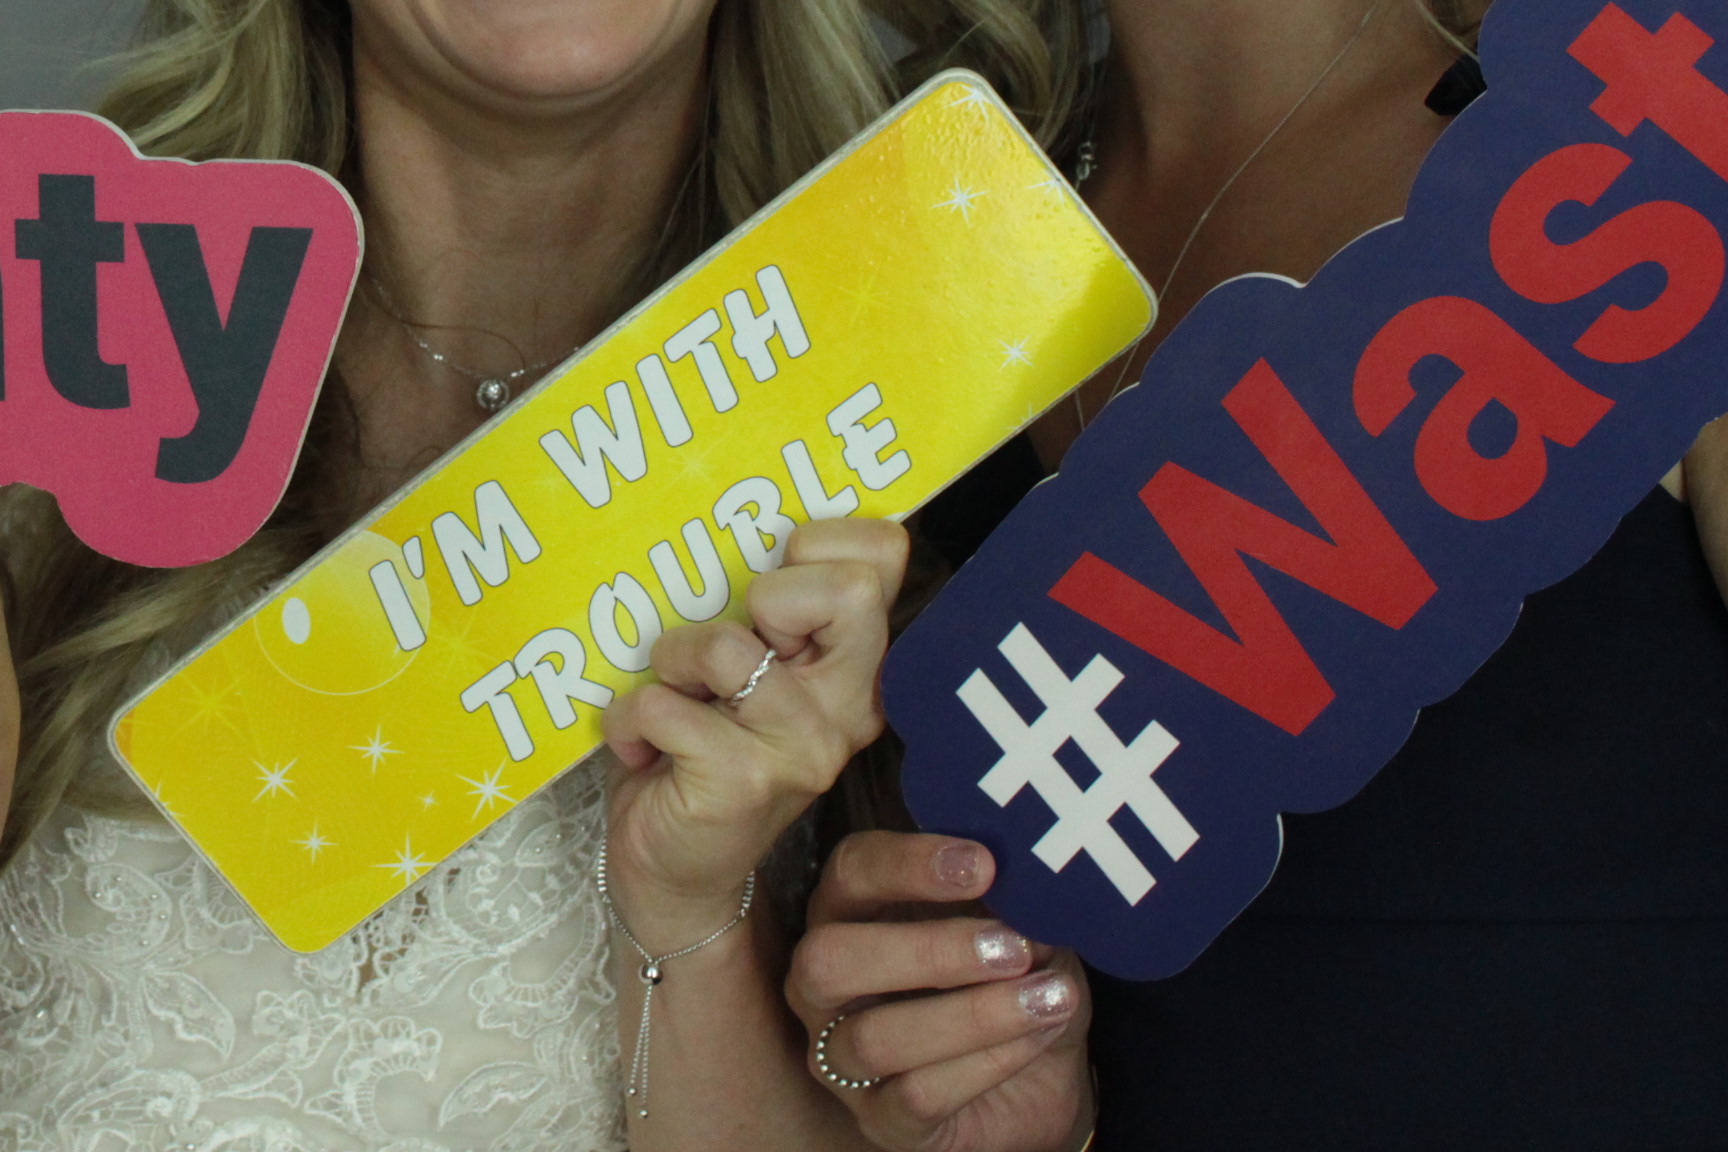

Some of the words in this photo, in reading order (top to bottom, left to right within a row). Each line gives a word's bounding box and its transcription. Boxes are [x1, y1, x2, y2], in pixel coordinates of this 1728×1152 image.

[368, 480, 542, 651] I'M
[538, 264, 811, 509] WITH
[459, 382, 911, 762] TROUBLE
